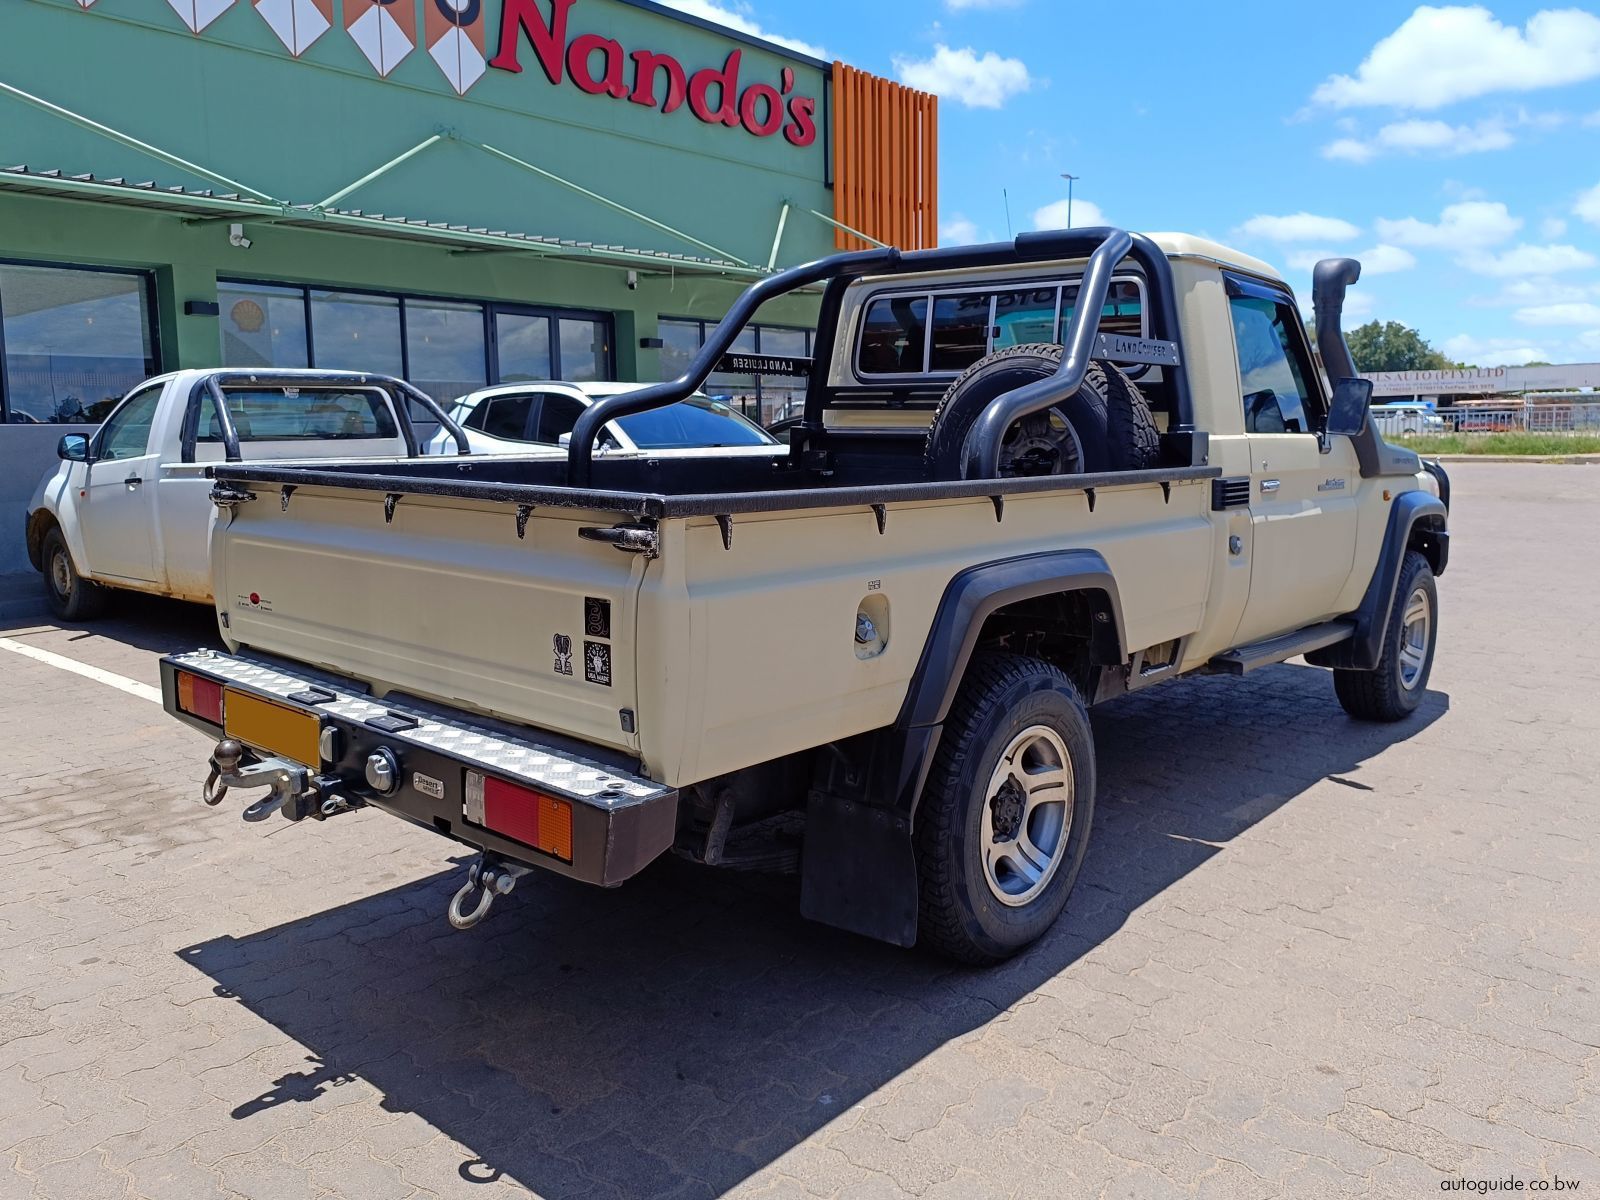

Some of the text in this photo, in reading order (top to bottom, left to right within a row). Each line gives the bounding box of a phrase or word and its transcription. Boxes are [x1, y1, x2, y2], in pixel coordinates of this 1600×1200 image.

[487, 0, 817, 147] Nando's
[1394, 370, 1432, 382] AUTO
[1435, 369, 1472, 381] (PTY)
[1476, 367, 1504, 379] LTD
